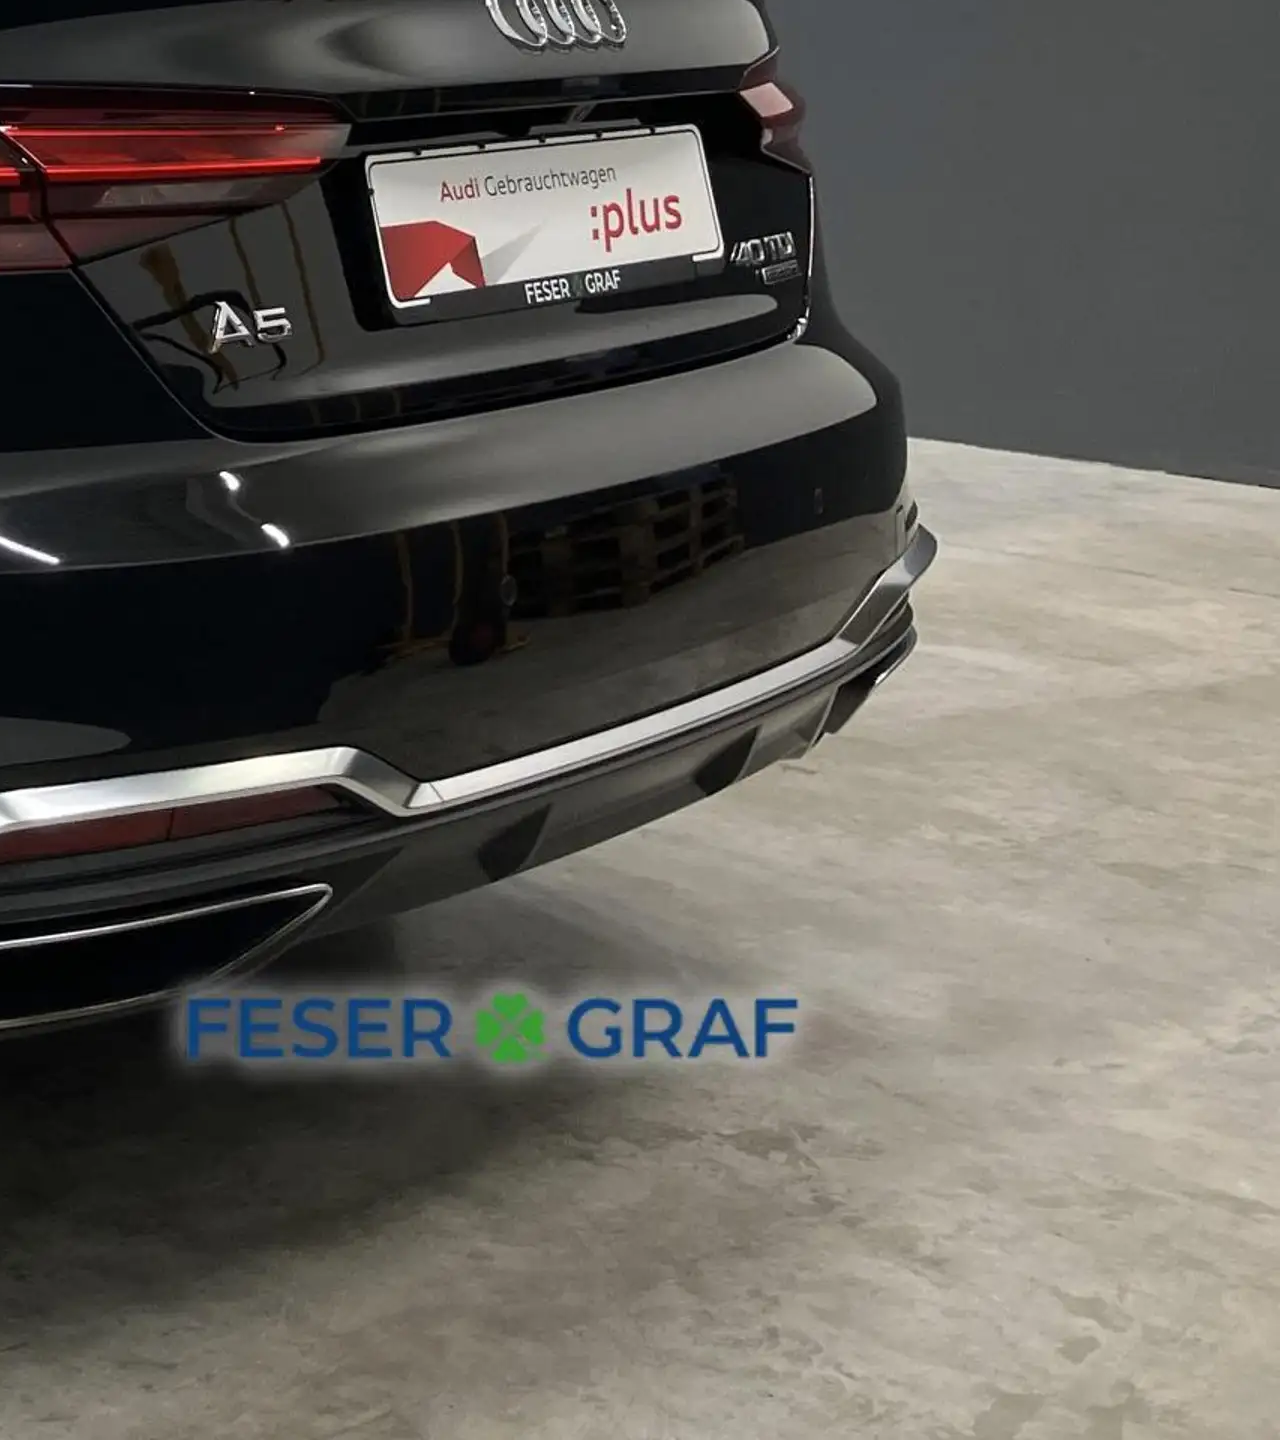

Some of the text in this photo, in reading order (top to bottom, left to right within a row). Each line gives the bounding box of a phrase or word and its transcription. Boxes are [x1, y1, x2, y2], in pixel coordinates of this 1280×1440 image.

[440, 165, 618, 203] Audi Gebrauchtwagen
[524, 269, 622, 304] FESER GRAF
[209, 301, 291, 354] A5
